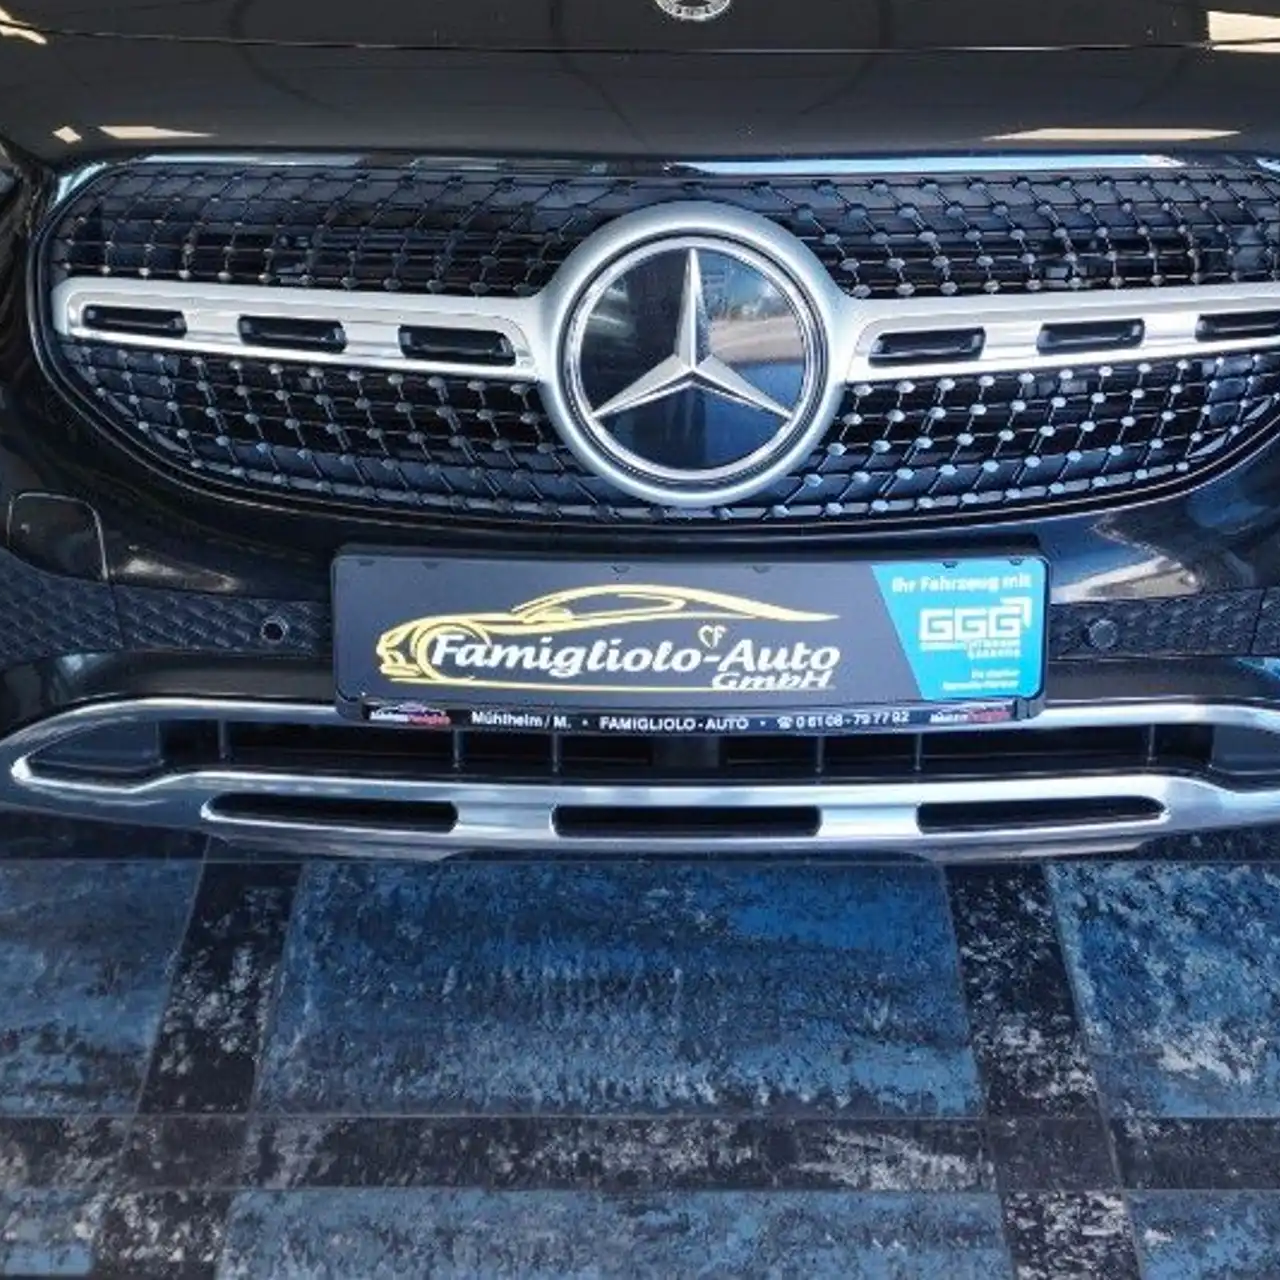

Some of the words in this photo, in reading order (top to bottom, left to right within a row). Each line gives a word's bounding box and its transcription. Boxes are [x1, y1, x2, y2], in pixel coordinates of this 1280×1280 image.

[919, 604, 1021, 643] GGG
[432, 634, 841, 677] Famigliolo-Auto
[712, 671, 833, 690] GmbH
